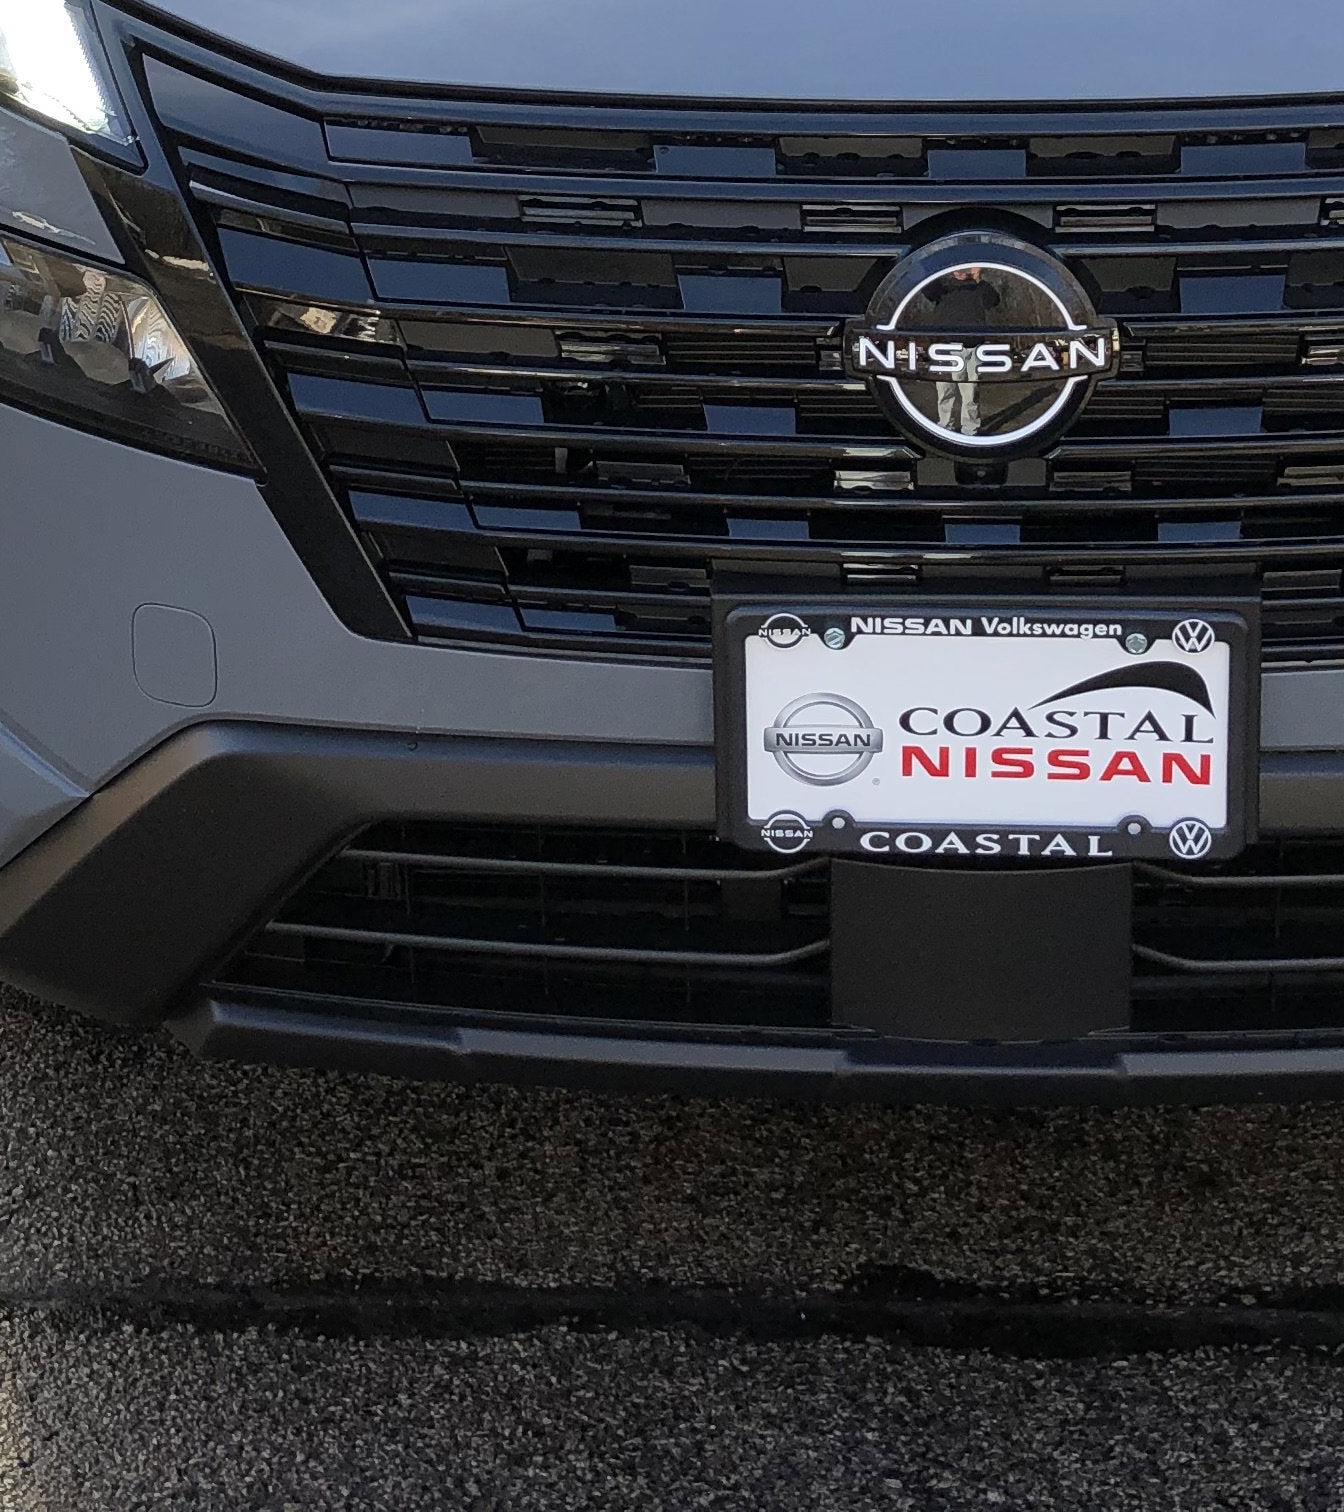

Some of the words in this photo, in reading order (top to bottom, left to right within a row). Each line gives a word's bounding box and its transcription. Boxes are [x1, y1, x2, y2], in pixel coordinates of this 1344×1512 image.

[857, 336, 1106, 374] NISSAN
[758, 627, 812, 638] NISSAN
[850, 616, 973, 636] NISSAN
[980, 616, 1123, 640] Volkswagen
[898, 706, 1215, 744] COASTAL
[775, 732, 872, 748] NISSAN
[901, 745, 1212, 786] NISSAN
[760, 829, 814, 838] NISSAN
[859, 831, 1113, 857] COASTAL
